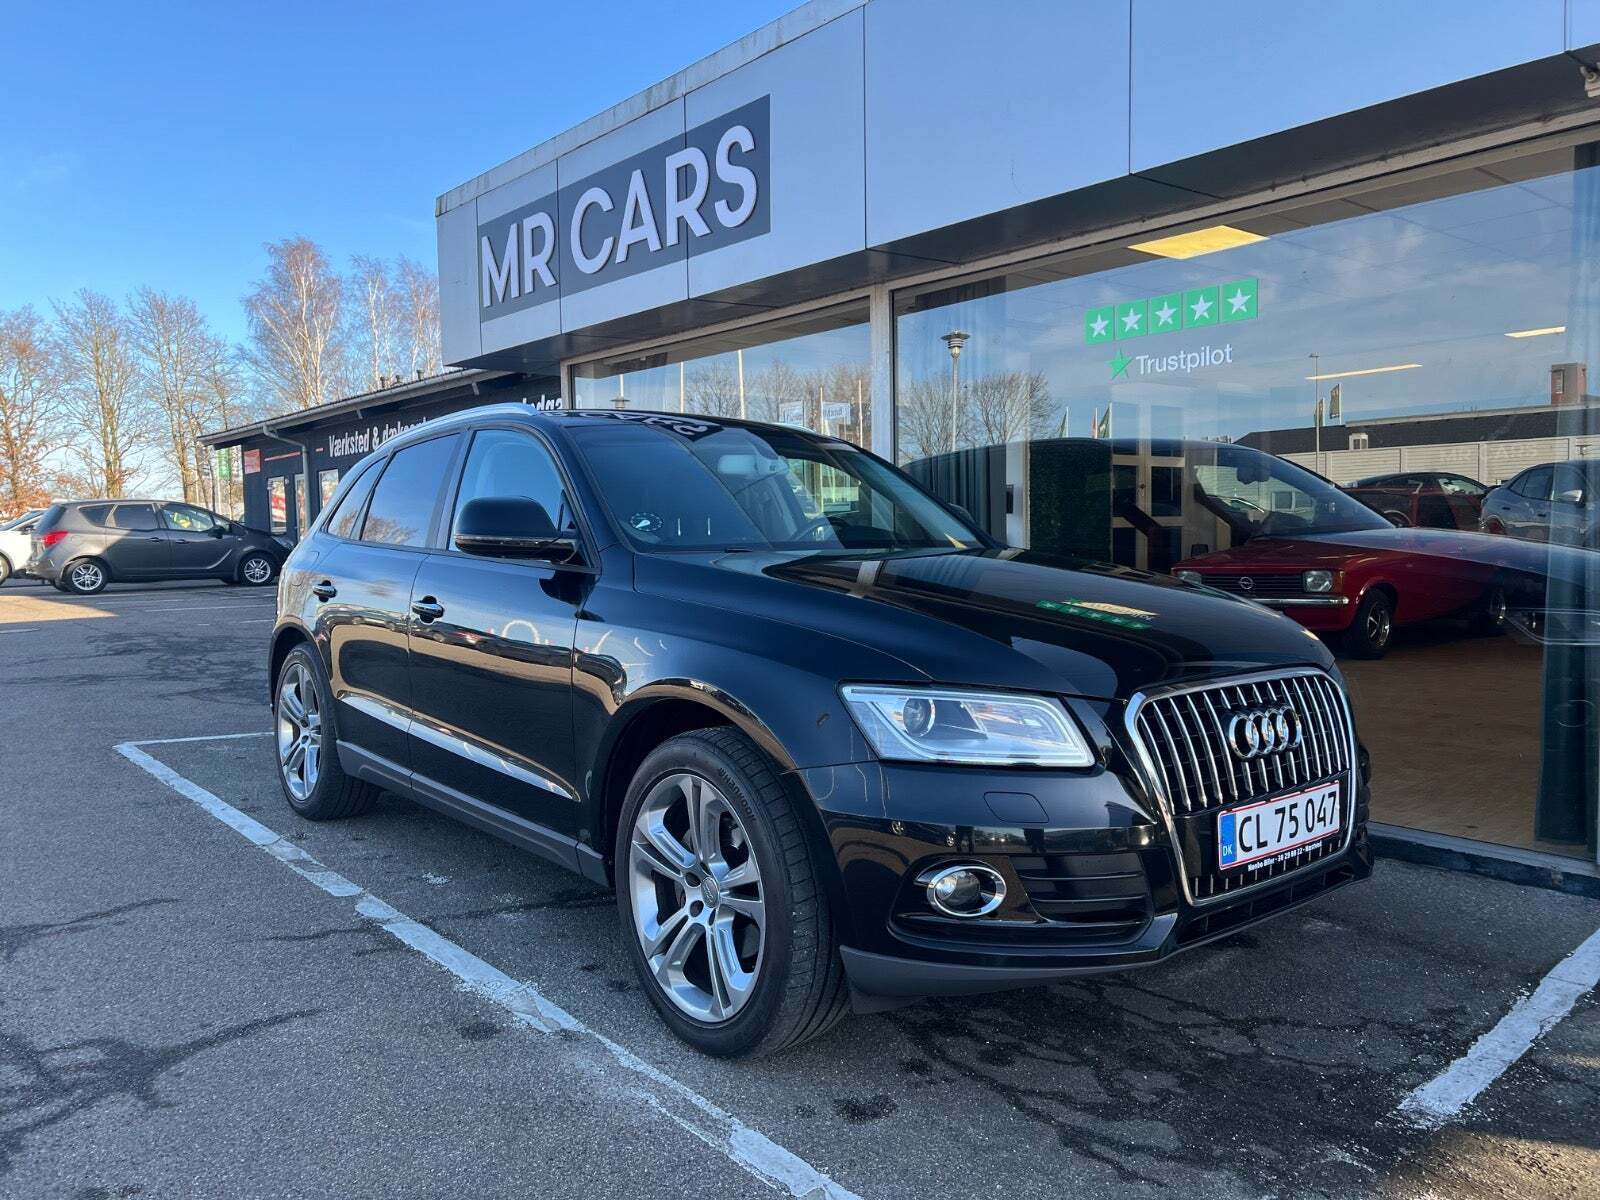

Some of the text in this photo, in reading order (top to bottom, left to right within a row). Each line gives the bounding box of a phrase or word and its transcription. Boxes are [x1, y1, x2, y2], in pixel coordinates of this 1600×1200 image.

[481, 124, 759, 308] MR CARS
[1135, 343, 1233, 375] Trustpilot
[328, 426, 370, 458] Værksted
[372, 425, 381, 450] &
[1238, 790, 1337, 852] CL 75 047
[1222, 843, 1233, 857] DK
